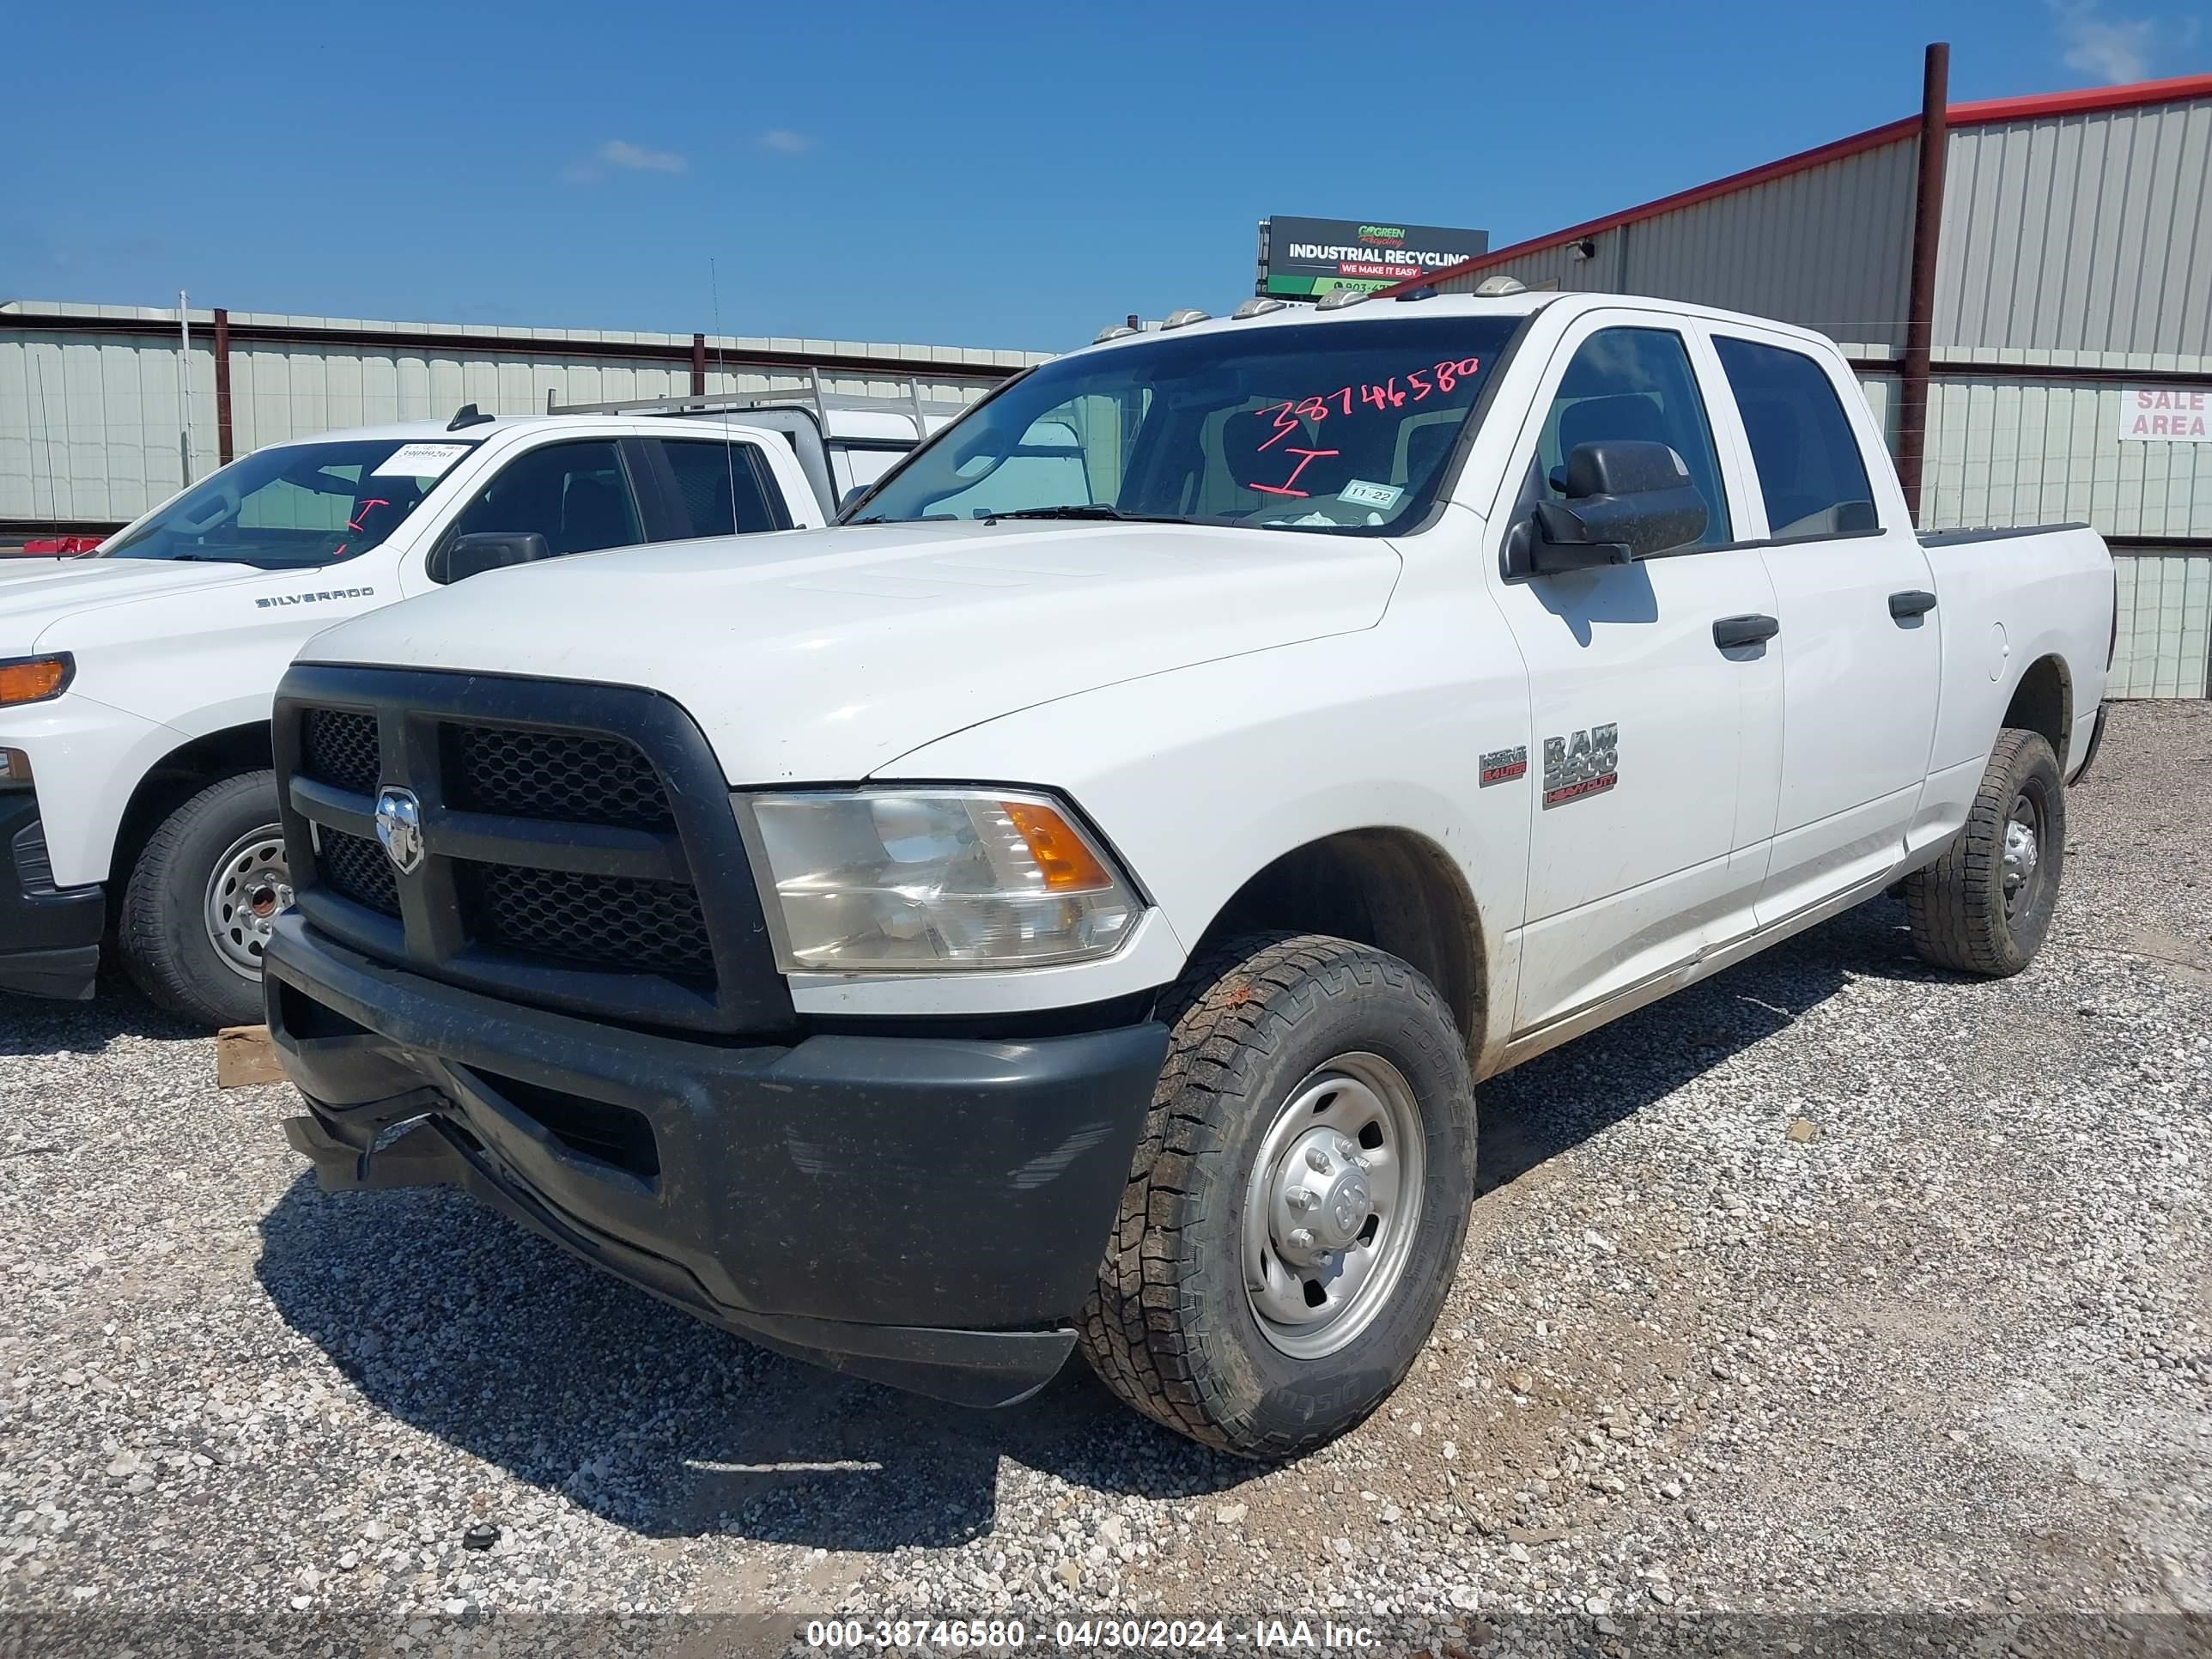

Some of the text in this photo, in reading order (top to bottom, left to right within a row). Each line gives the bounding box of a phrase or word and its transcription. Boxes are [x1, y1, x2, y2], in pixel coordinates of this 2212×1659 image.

[1289, 243, 1382, 262] INDUSTRIAL
[1341, 264, 1418, 276] WE MAKE IT EASY
[1255, 357, 1479, 452] 38746580
[2137, 389, 2205, 410] SALE
[2131, 415, 2206, 436] AREA
[254, 586, 374, 608] SILVERADO
[1543, 722, 1618, 764] RAM
[1548, 774, 1616, 804] HEAVY DUTY
